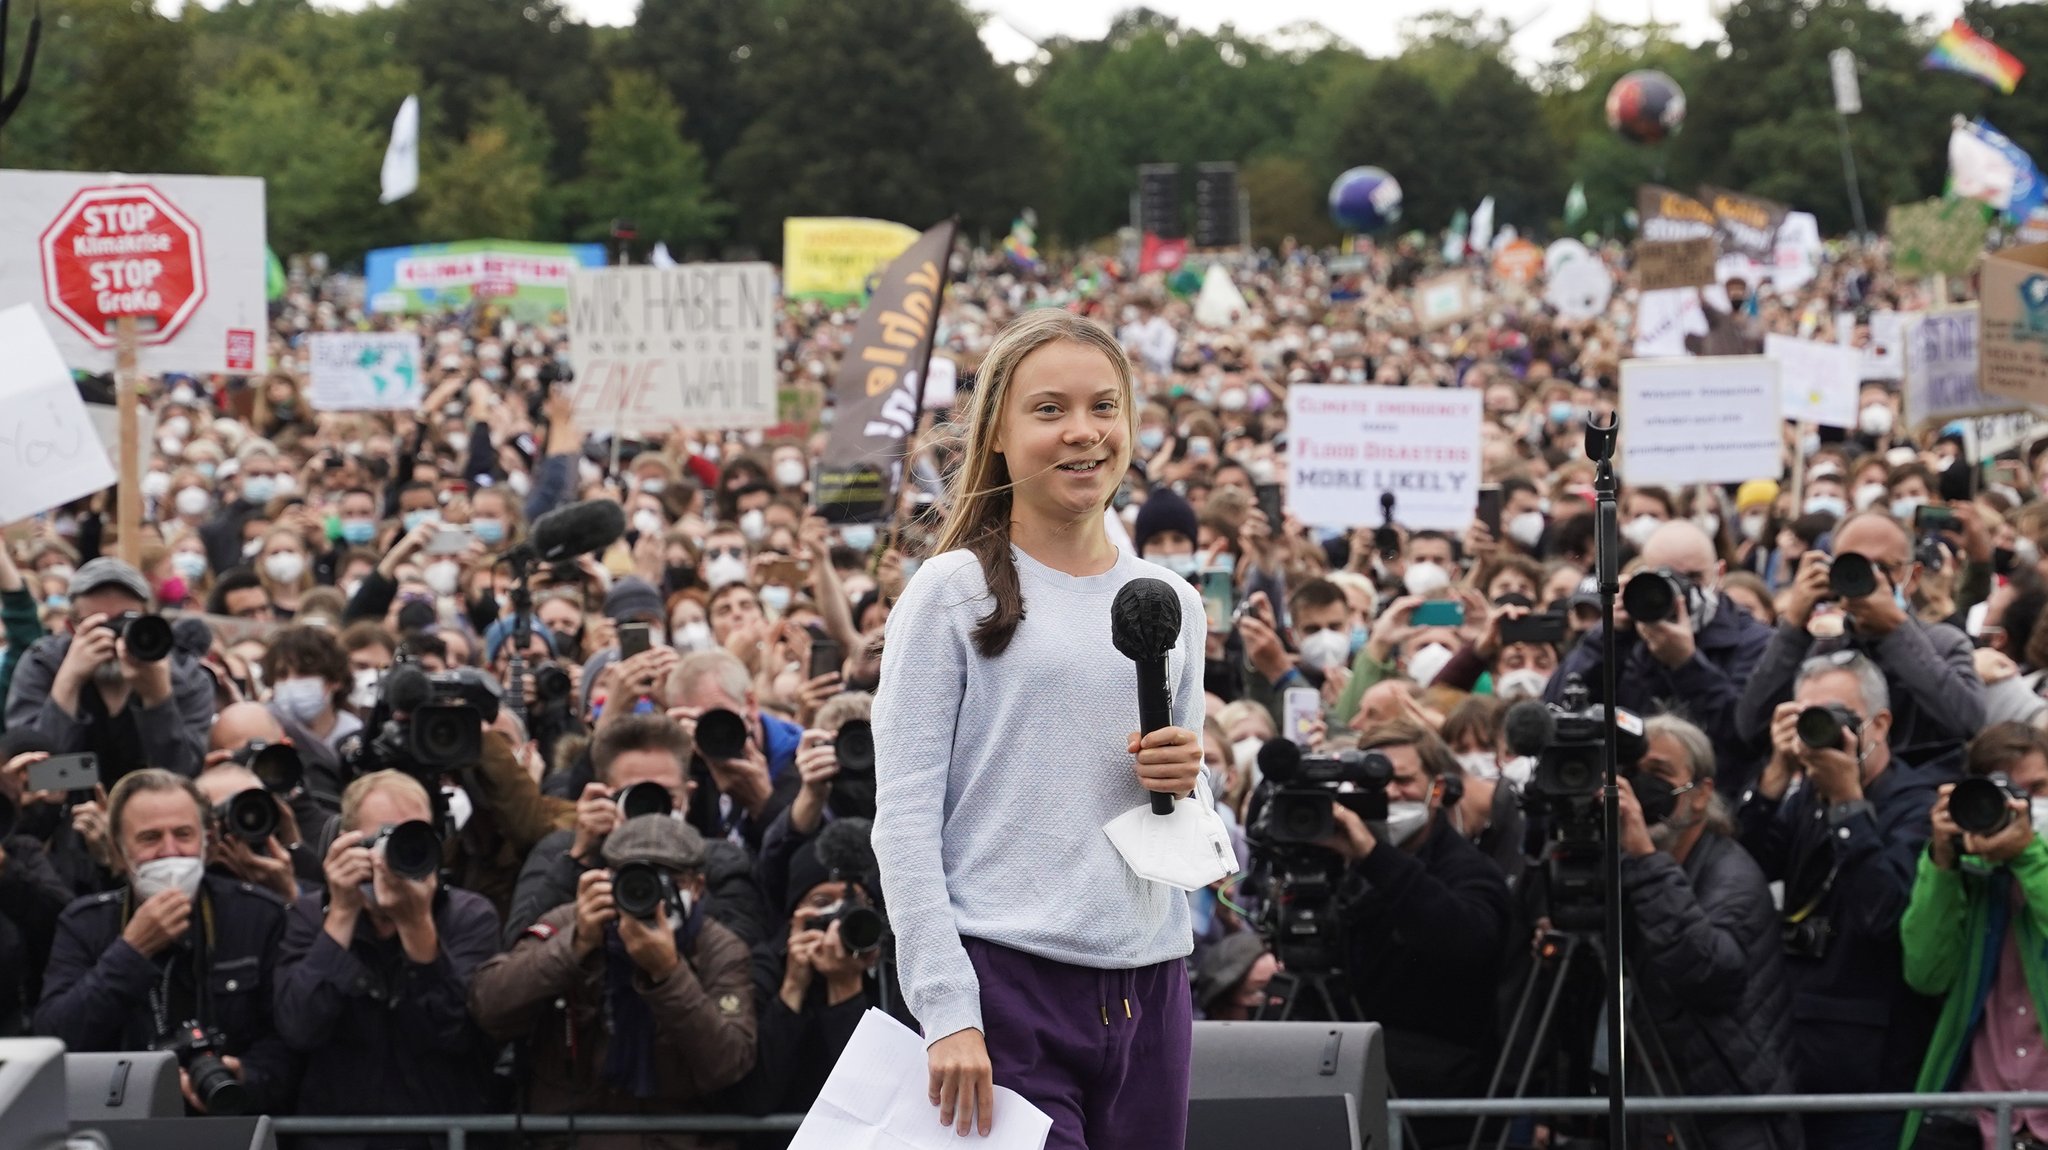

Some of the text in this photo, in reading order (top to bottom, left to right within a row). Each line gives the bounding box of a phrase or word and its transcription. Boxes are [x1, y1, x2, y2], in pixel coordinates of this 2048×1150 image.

[83, 203, 156, 235] STOP
[73, 233, 171, 256] Klimakrise
[89, 259, 162, 291] STOP
[97, 288, 162, 313] GroKo
[568, 268, 766, 336] WIR HABEN
[1297, 468, 1467, 491] MORE LIKELY
